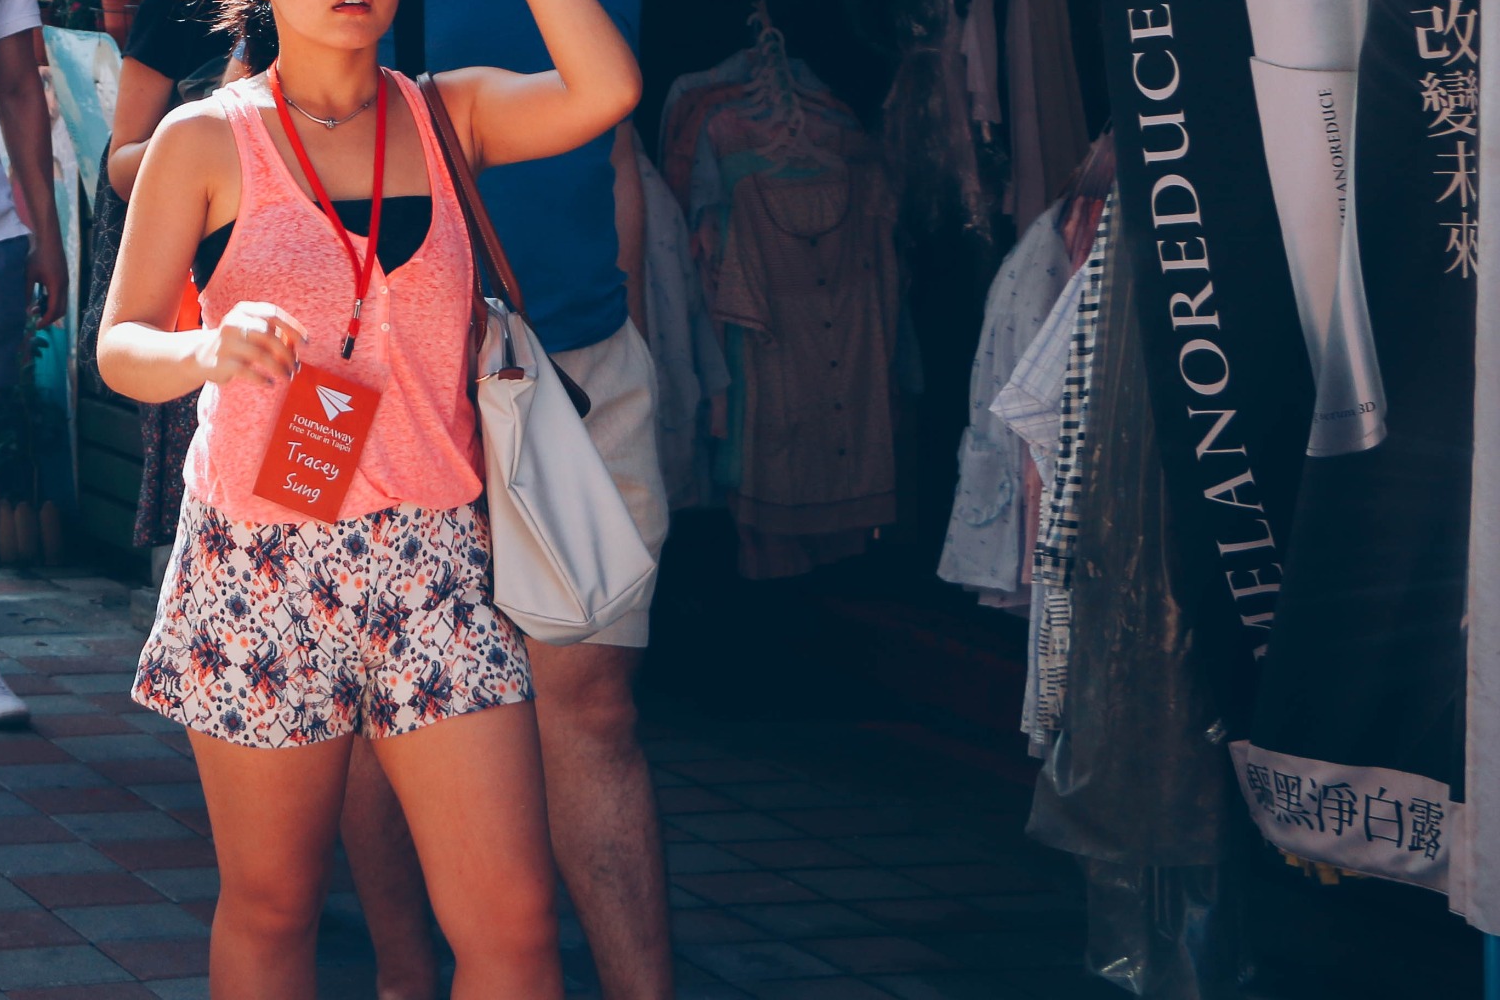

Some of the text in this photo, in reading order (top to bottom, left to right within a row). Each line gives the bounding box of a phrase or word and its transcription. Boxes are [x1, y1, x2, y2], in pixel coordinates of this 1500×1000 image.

[288, 422, 305, 435] Free
[306, 428, 324, 442] Tour
[331, 438, 352, 454] Taipei
[287, 441, 340, 481] Tracey
[283, 472, 321, 504] Sung
